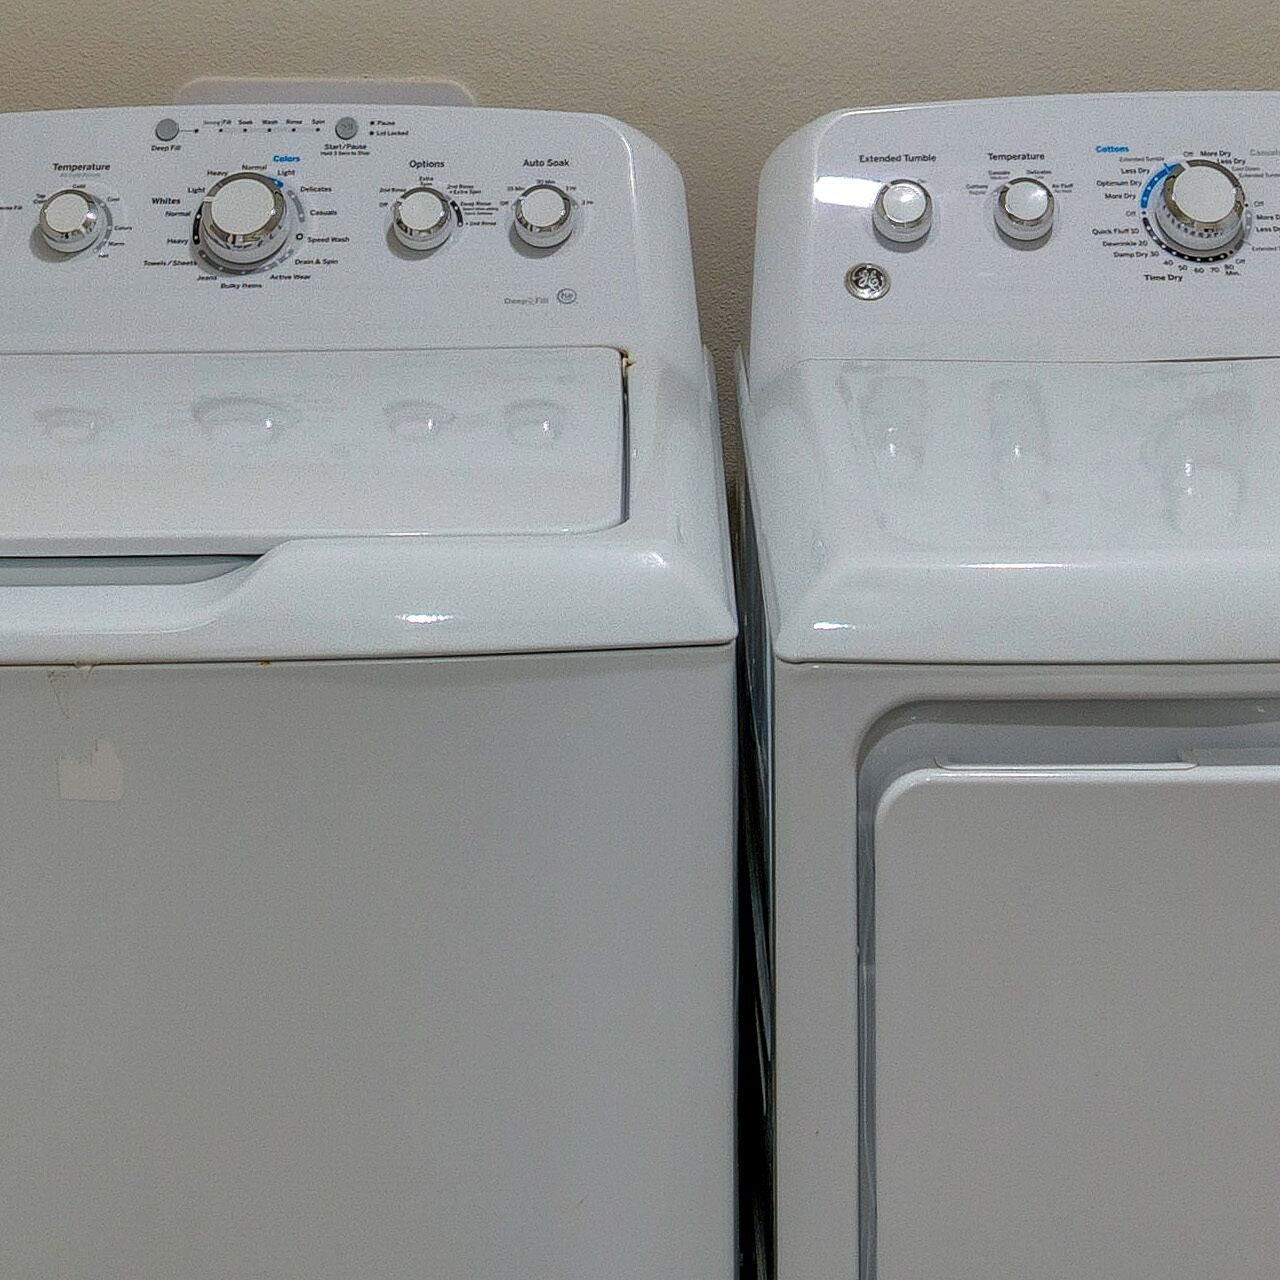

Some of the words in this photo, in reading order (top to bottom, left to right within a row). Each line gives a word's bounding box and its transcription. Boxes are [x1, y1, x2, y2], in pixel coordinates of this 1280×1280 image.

[988, 152, 1045, 161] Temperature
[1219, 150, 1231, 158] Dry
[859, 154, 901, 163] Extended
[904, 154, 937, 162] Tumble
[409, 160, 445, 169] Options
[523, 159, 544, 167] Auto
[547, 159, 569, 167] Soak
[53, 163, 111, 172] Temperature
[1130, 180, 1142, 188] Dry
[1092, 228, 1112, 236] Quick
[1167, 274, 1183, 282] Dry
